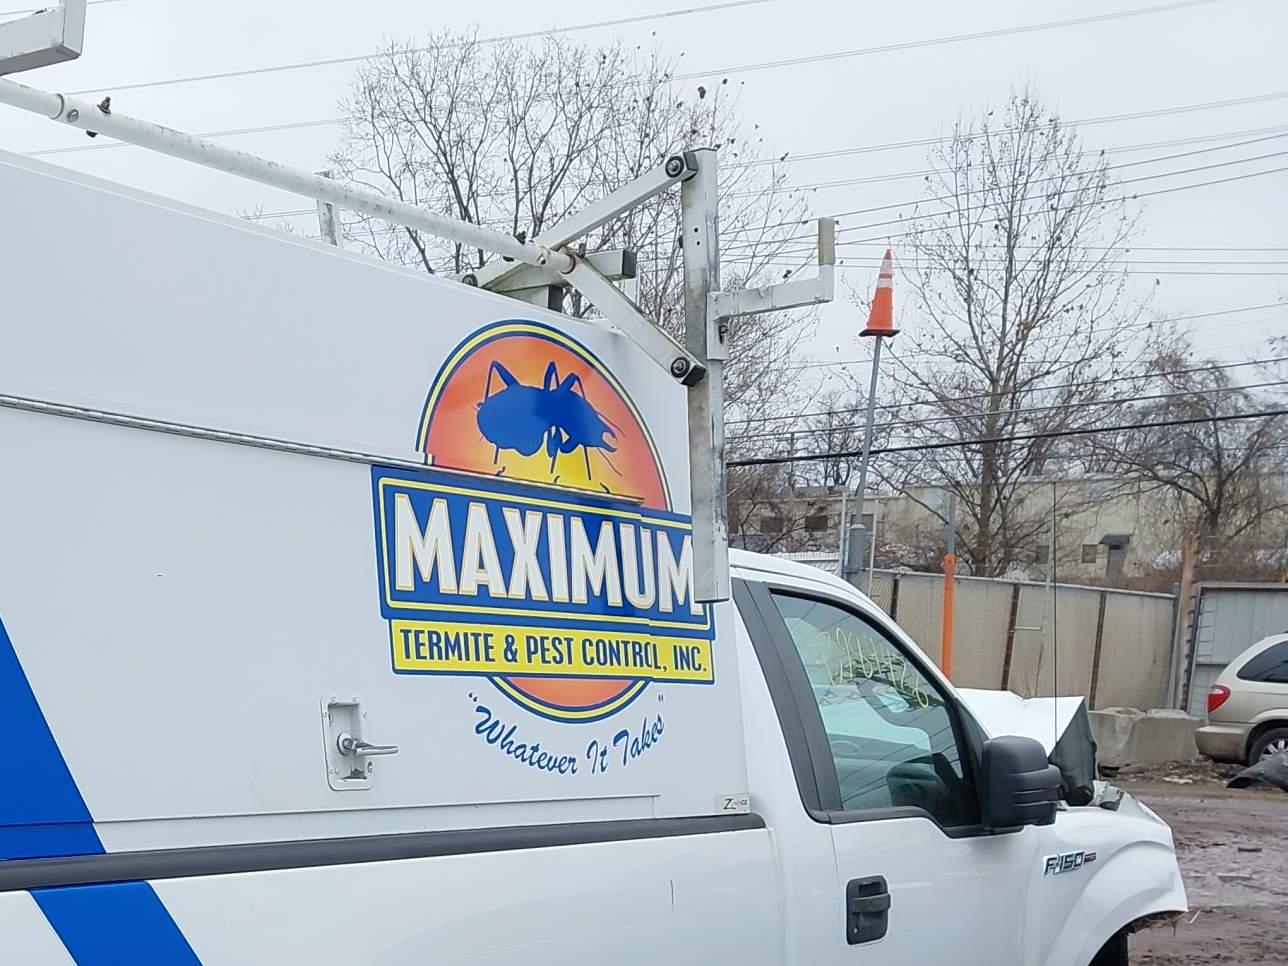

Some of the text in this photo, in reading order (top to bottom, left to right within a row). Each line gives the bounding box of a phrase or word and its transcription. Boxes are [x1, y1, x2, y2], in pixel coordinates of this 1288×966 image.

[394, 492, 705, 616] MAXIMUM
[400, 629, 707, 672] TERMITE & PEST CONTROL, INC.
[586, 740, 609, 774] It
